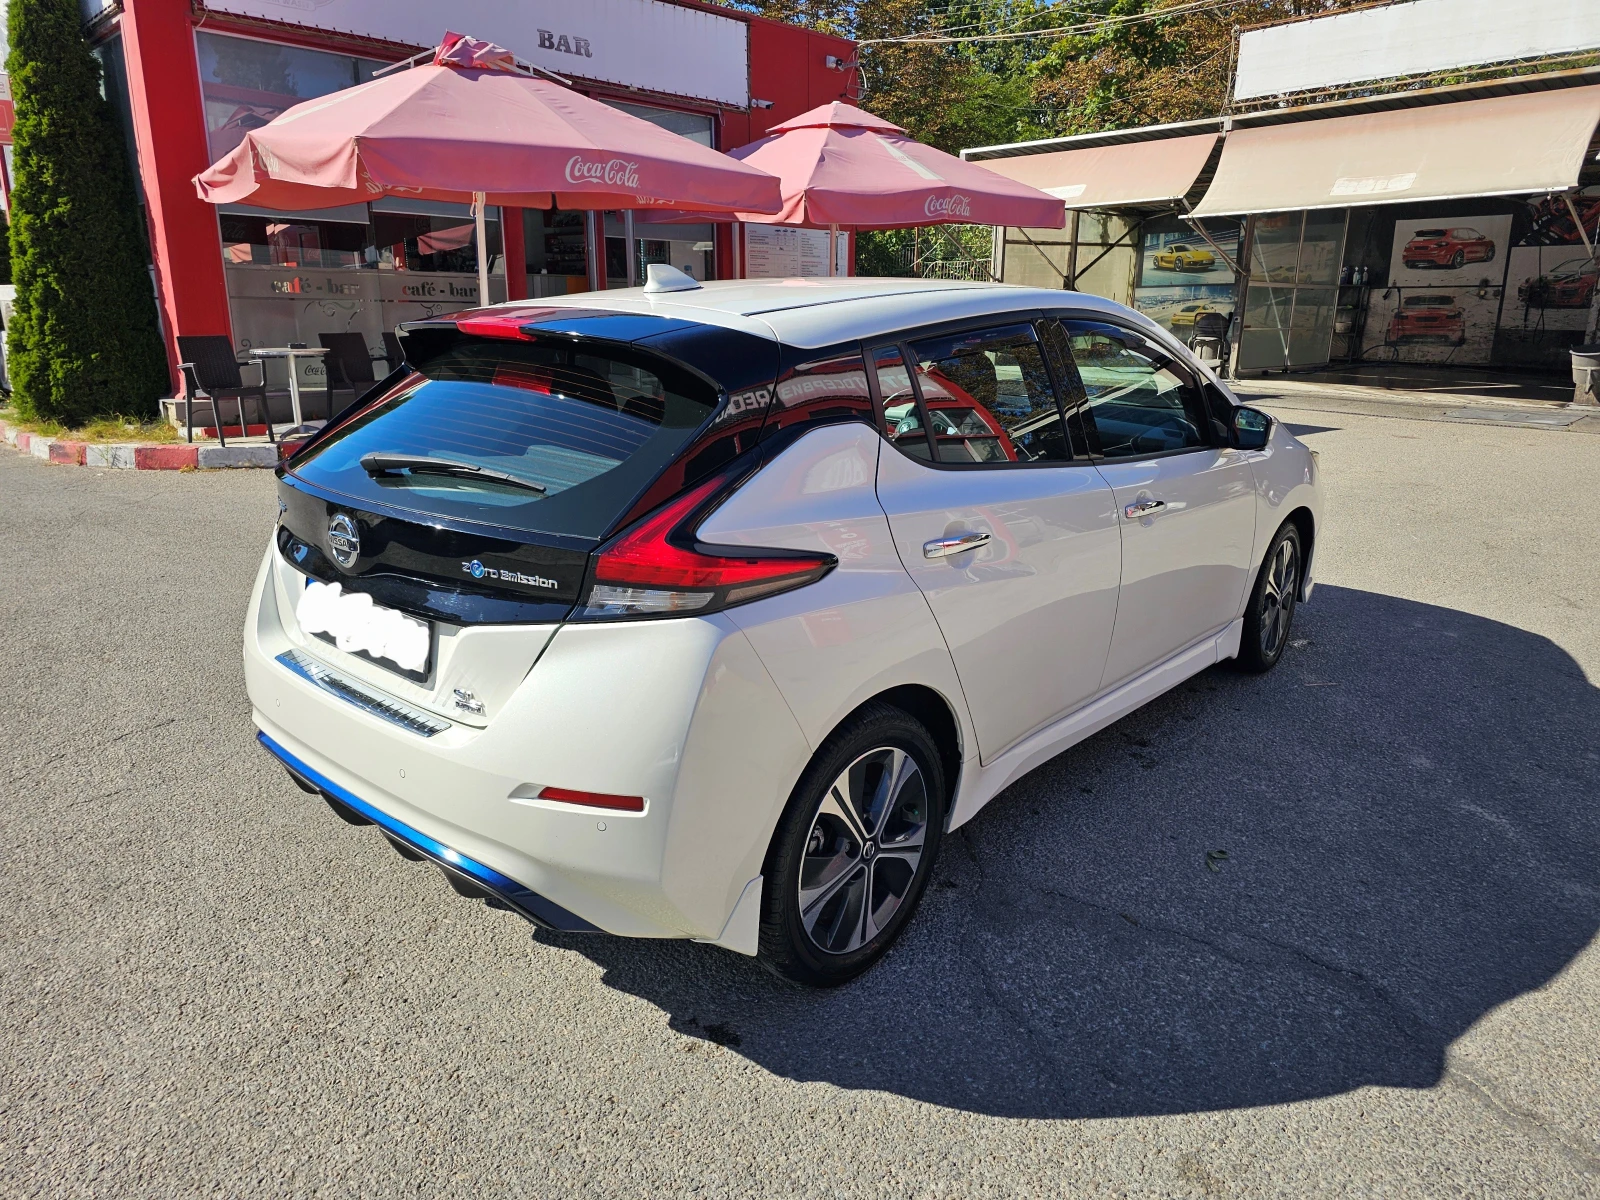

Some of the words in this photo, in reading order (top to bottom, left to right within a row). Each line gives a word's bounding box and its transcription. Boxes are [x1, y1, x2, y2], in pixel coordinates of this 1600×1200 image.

[537, 28, 593, 58] BAR
[565, 155, 640, 188] Coca-Cola
[925, 194, 972, 217] Coca-Cola
[271, 276, 312, 294] café
[327, 278, 359, 295] bar
[402, 281, 437, 297] café
[449, 282, 478, 298] bar
